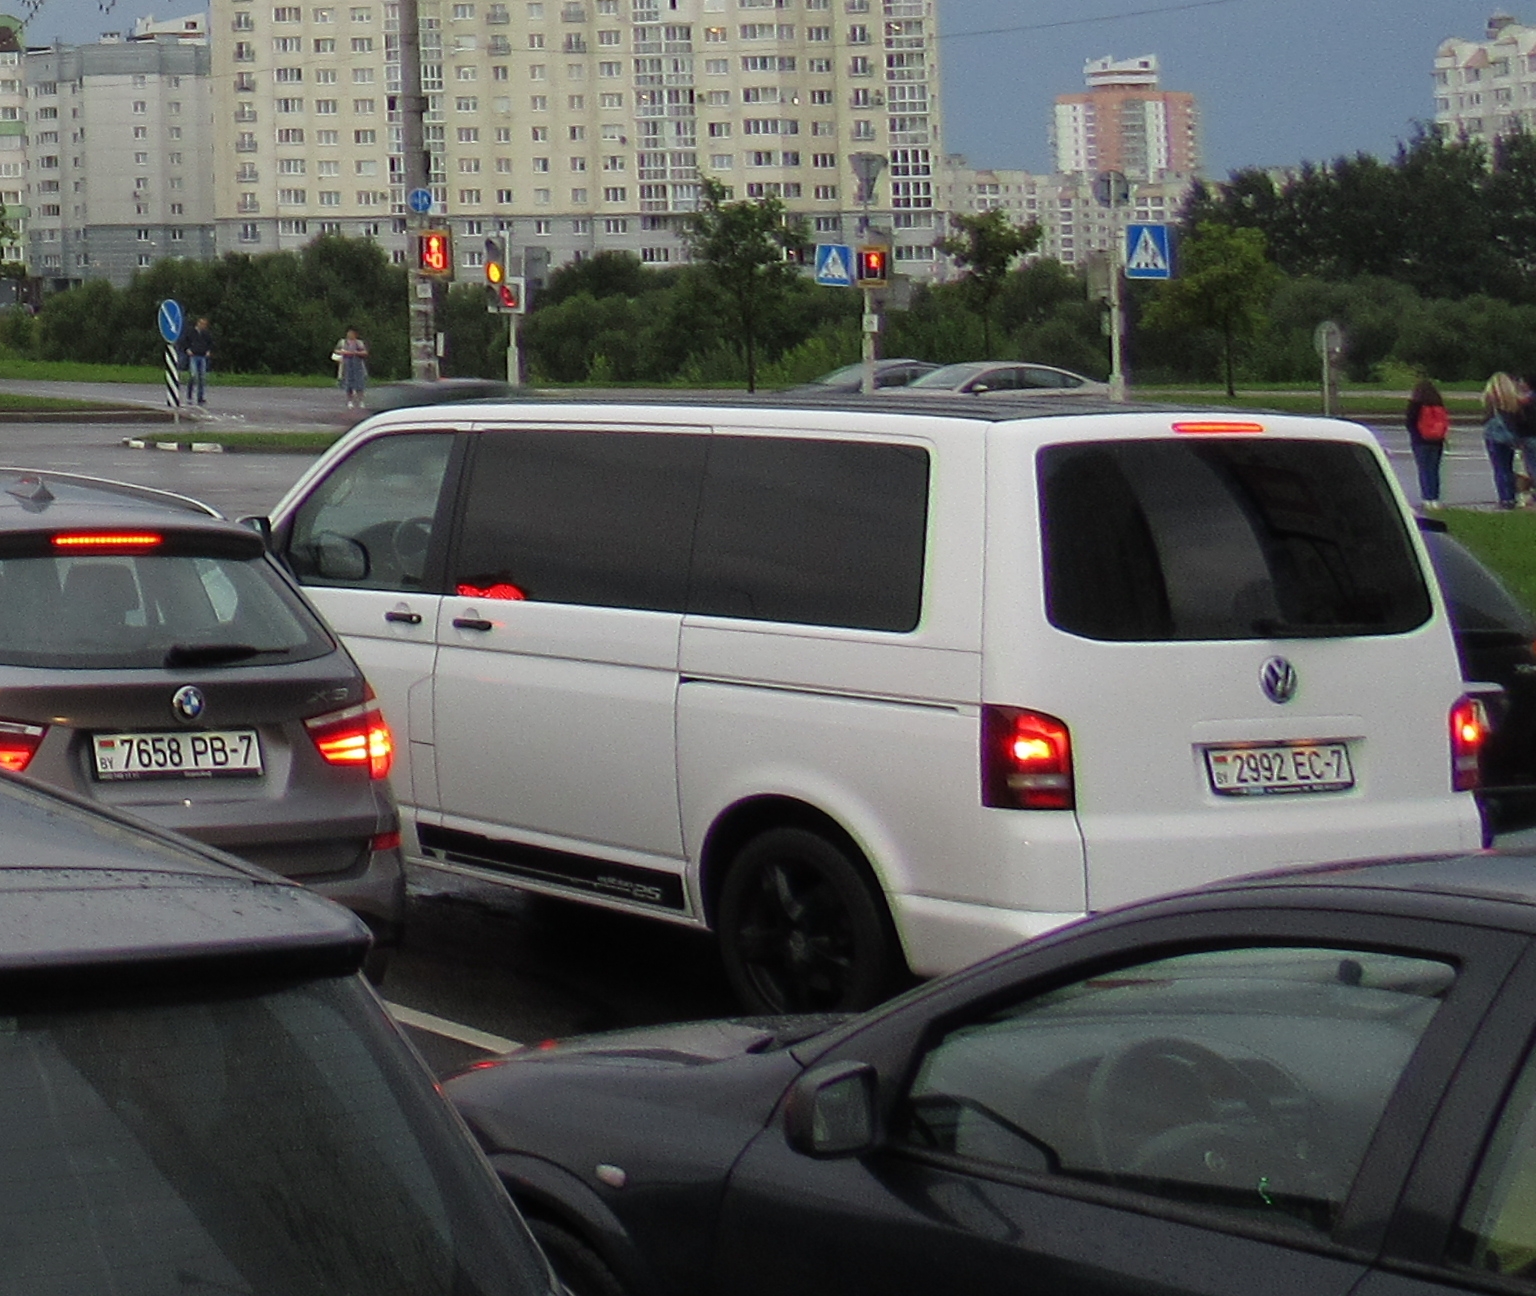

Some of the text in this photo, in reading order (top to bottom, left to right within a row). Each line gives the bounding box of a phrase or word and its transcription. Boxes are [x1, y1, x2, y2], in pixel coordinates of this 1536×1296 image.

[100, 756, 114, 770] BY
[120, 735, 253, 769] 7658 PB-7
[1234, 749, 1343, 783] 2992 EC-7
